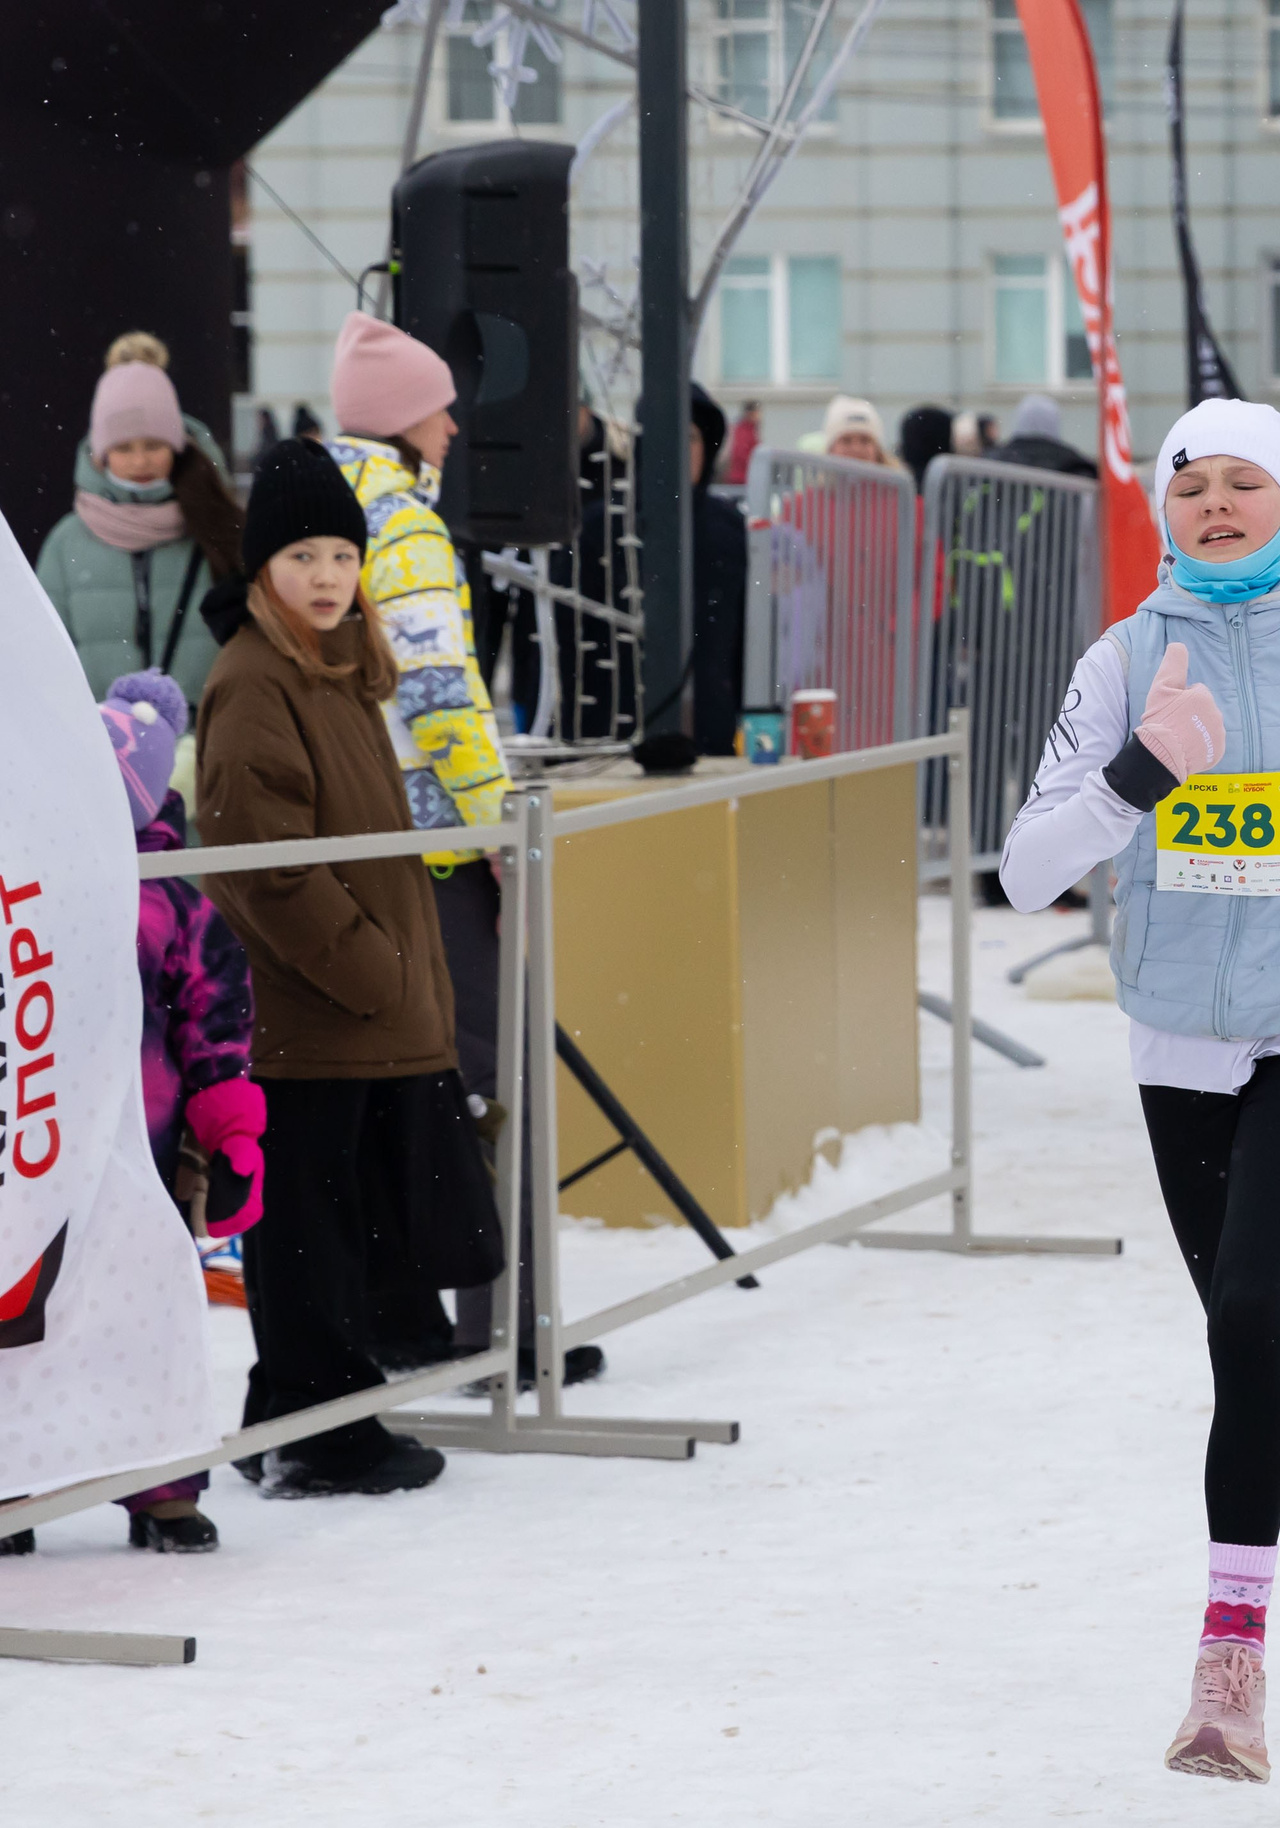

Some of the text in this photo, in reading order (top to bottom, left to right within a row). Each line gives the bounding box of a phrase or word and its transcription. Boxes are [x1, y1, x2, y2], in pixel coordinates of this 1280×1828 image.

[1193, 784, 1218, 792] РСХБ
[1172, 802, 1275, 849] 238
[0, 874, 61, 1179] СПОРТ
